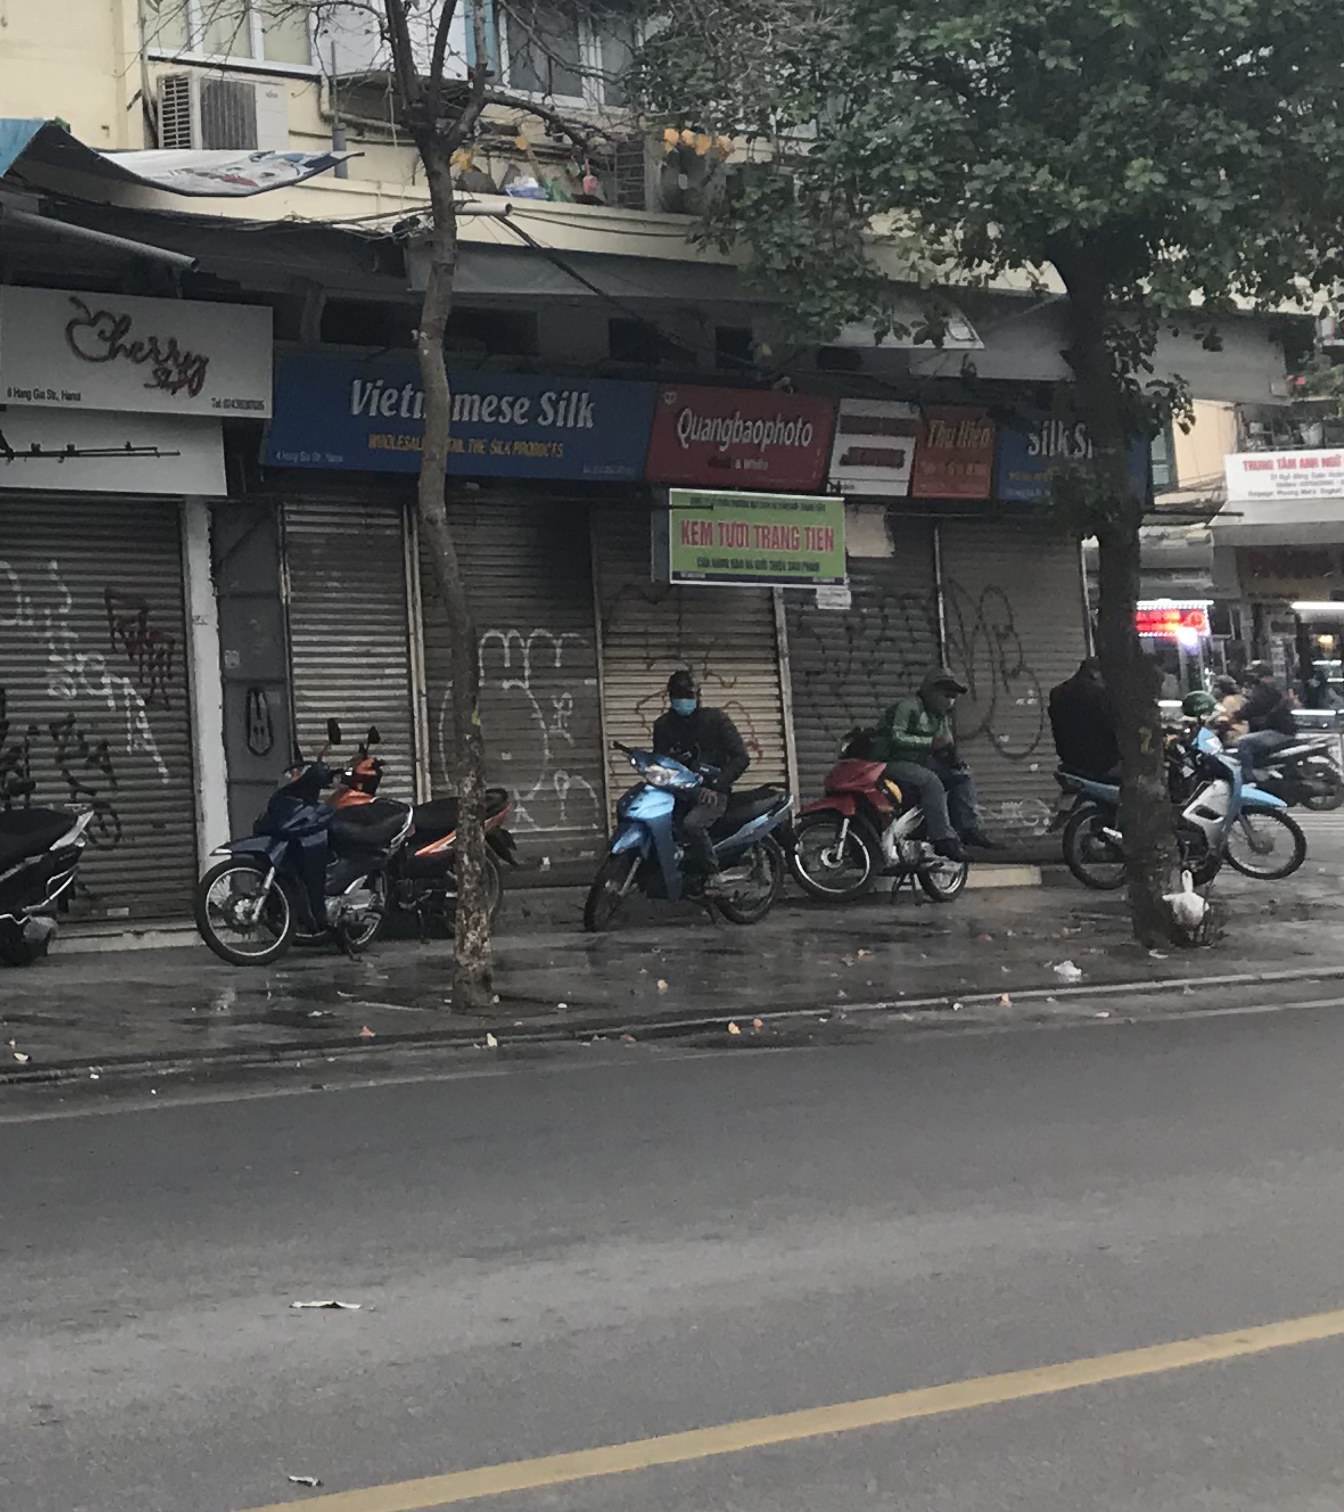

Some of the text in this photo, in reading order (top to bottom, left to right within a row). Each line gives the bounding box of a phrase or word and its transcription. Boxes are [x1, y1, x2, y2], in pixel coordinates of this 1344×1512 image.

[350, 377, 596, 430] Vietmese Silk
[368, 433, 424, 451] WHOLESAL
[677, 407, 813, 453] Quangbaophoto
[680, 519, 713, 547] KEM
